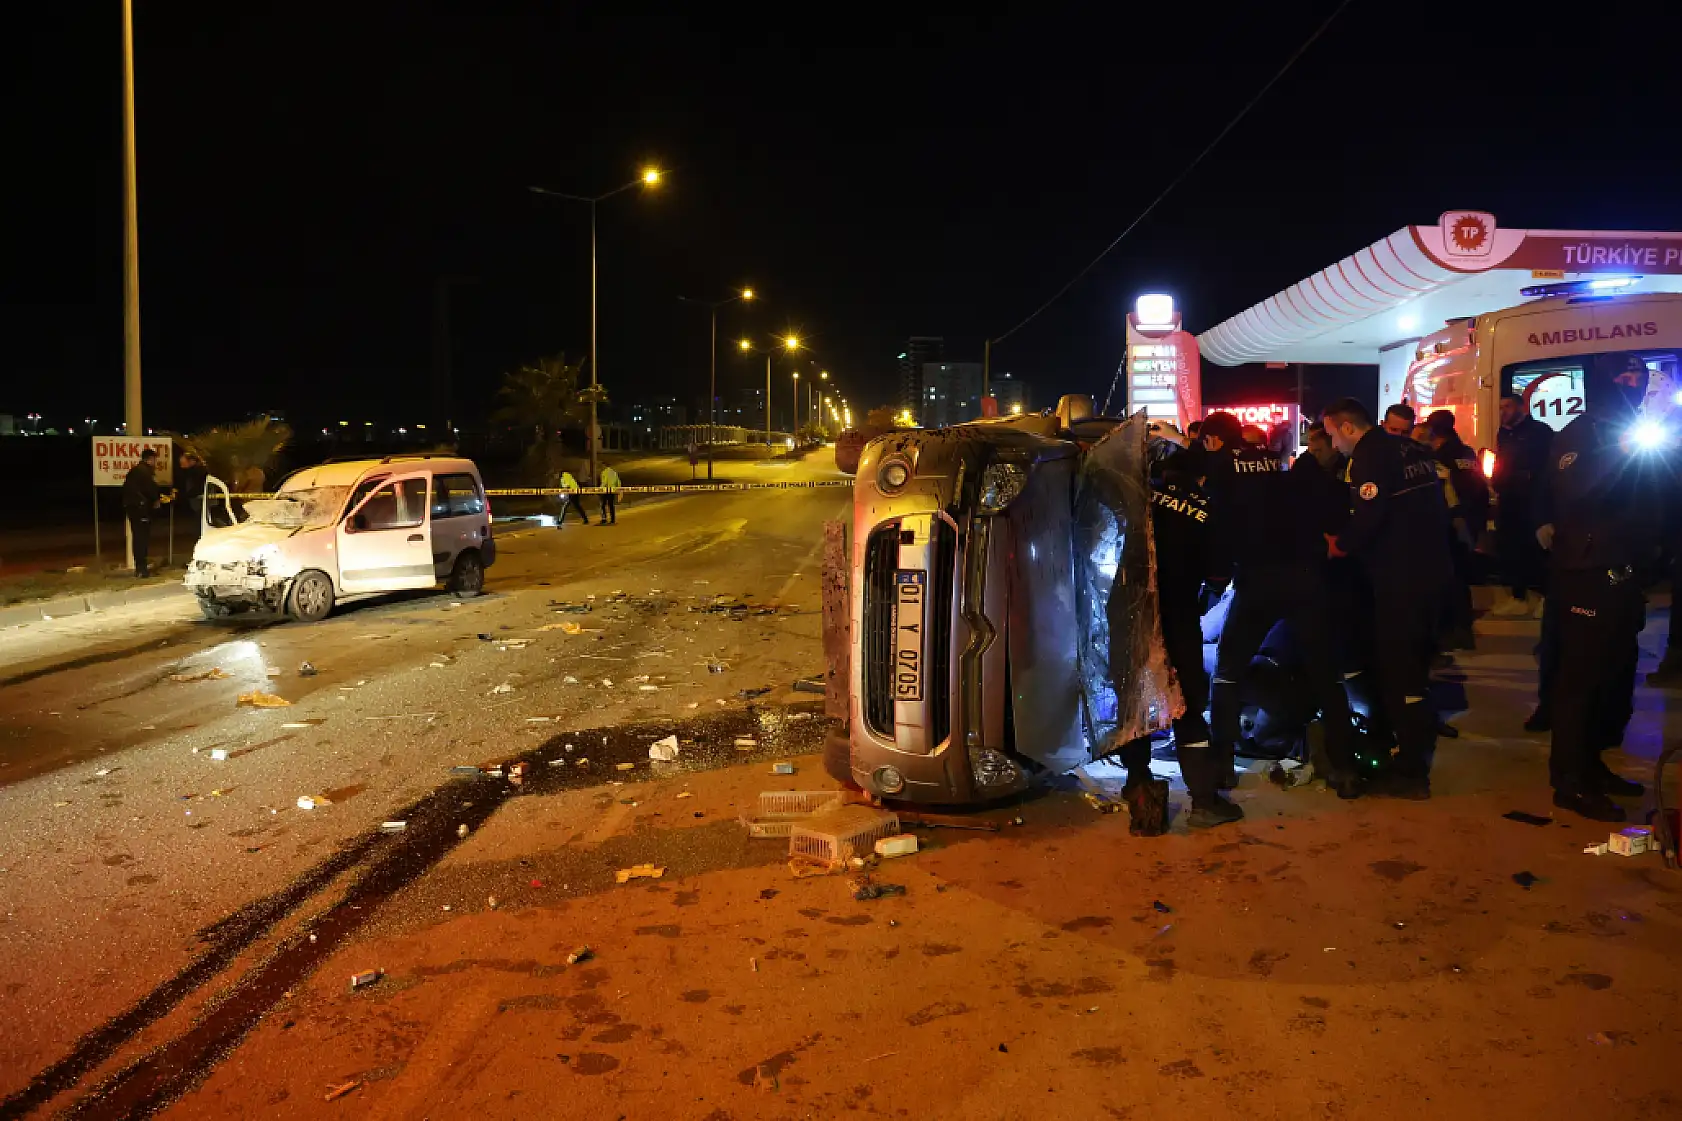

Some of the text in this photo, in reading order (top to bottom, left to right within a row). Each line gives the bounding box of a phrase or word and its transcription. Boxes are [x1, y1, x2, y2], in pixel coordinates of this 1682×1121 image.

[1461, 226, 1479, 240] TP
[1563, 243, 1682, 266] TÜRKİYE P
[1527, 321, 1659, 346] AMBULANS
[1532, 396, 1584, 418] 112
[900, 585, 920, 604] 01
[899, 624, 919, 633] Y
[898, 650, 918, 695] 0705
